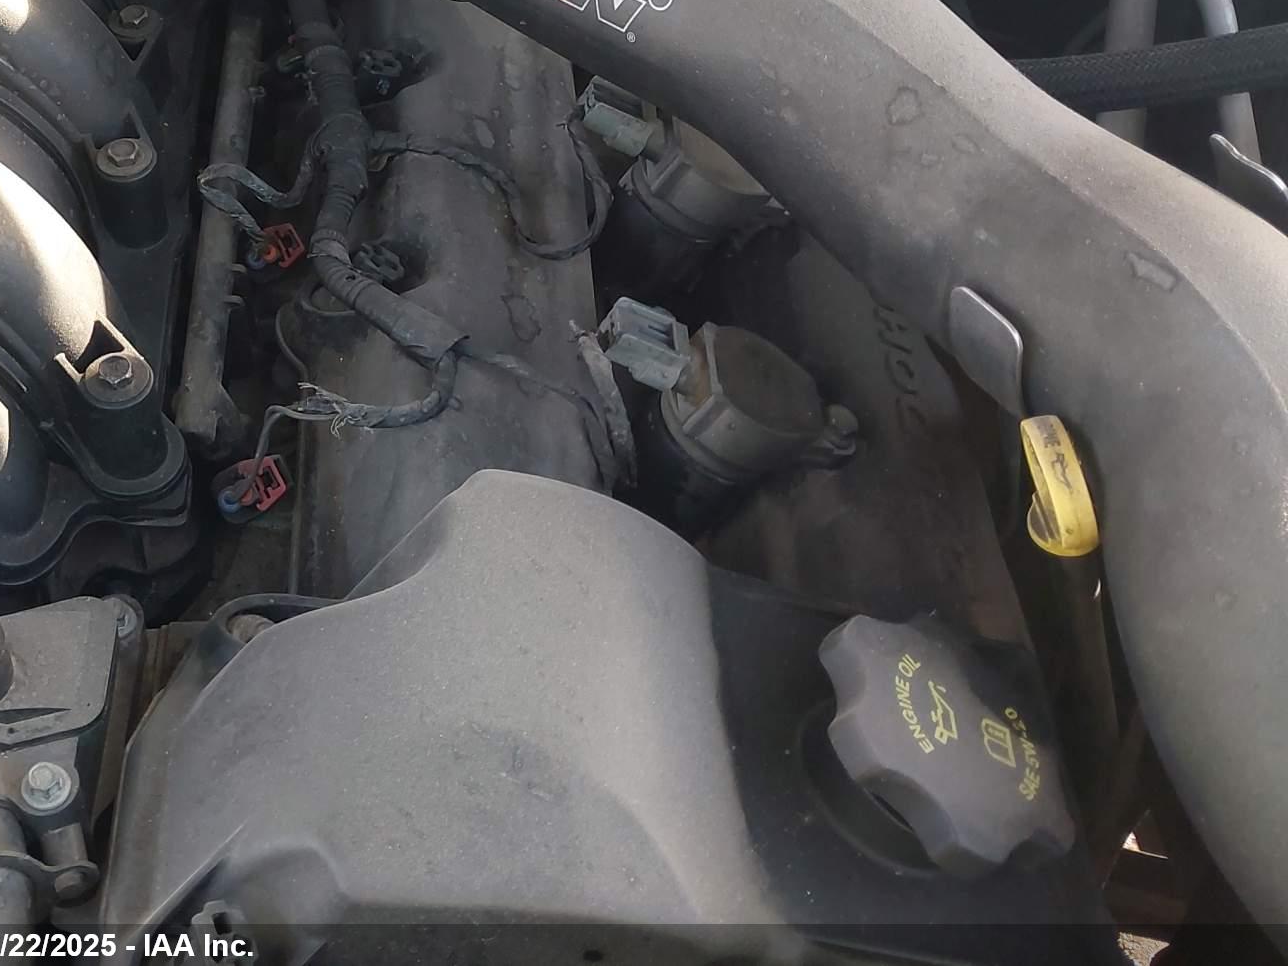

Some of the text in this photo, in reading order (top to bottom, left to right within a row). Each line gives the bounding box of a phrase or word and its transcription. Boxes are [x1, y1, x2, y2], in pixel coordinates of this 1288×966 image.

[895, 653, 935, 754] ENGINE OIL
[1018, 767, 1041, 801] SAE
